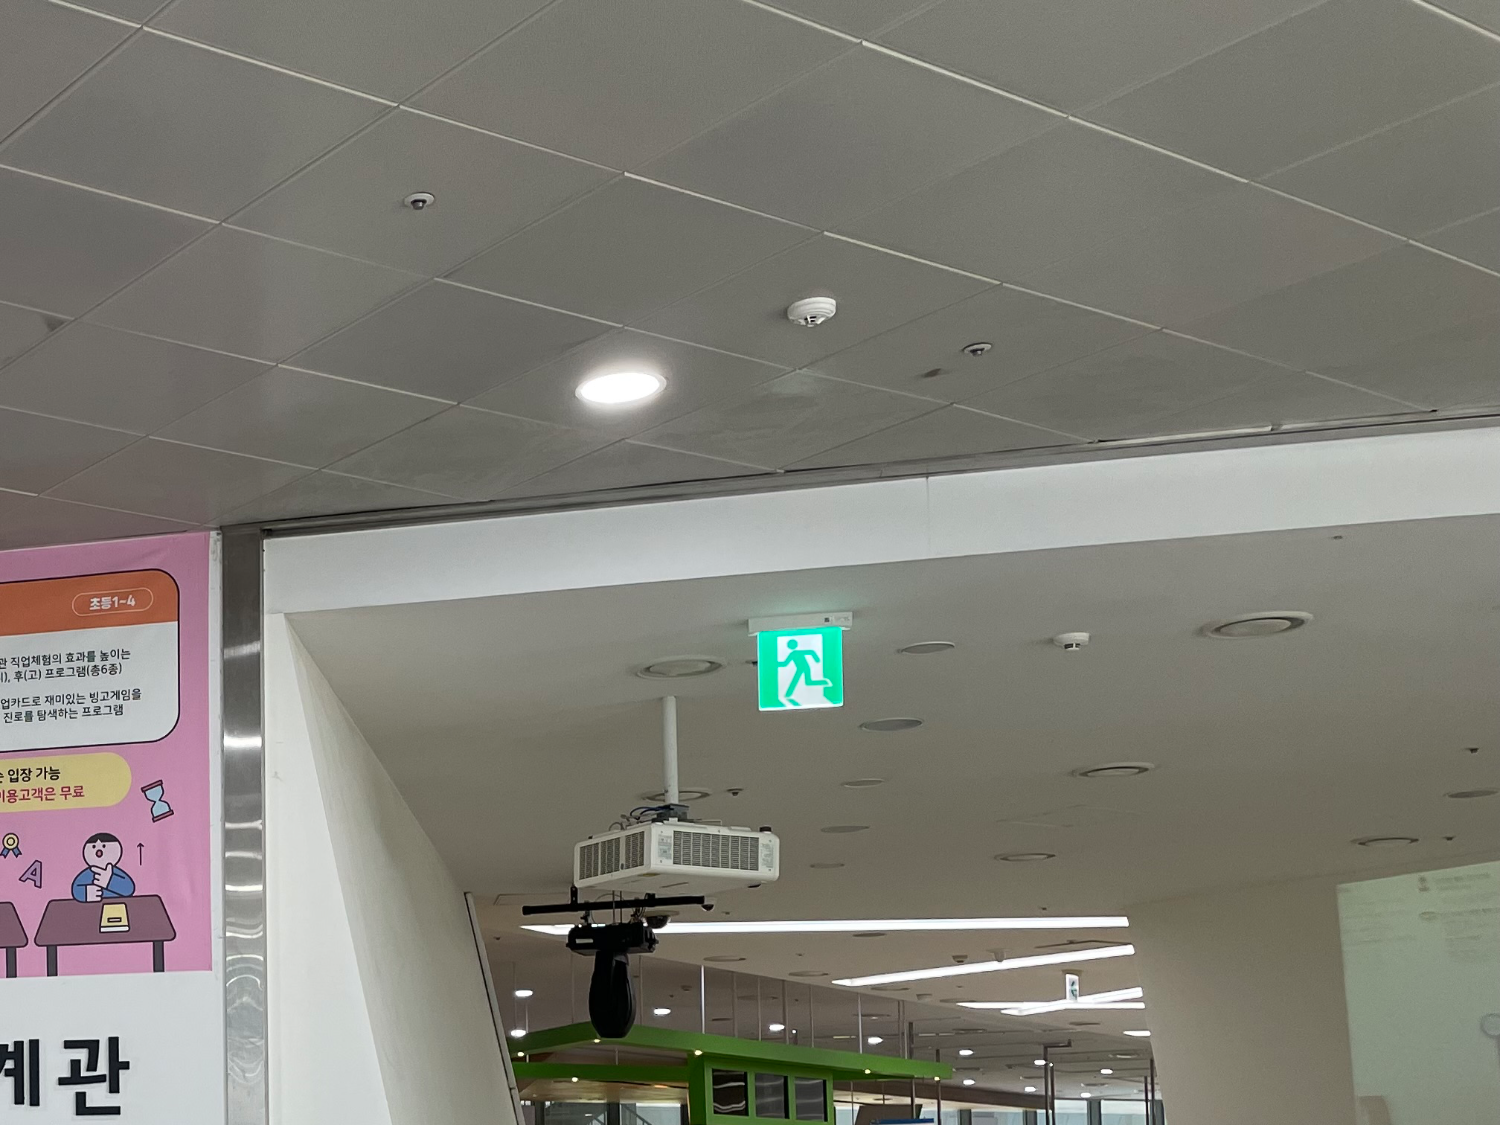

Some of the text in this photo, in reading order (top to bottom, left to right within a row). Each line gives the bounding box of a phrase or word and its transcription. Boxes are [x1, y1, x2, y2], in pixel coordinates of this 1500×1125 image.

[10, 654, 61, 668] 직업체험의
[65, 652, 95, 664] 효과를
[100, 649, 130, 662] 높이는
[44, 692, 85, 706] 재미있는
[89, 689, 141, 704] 빙고게임을
[3, 710, 33, 723] 진로를
[37, 707, 77, 721] 탐색하는
[82, 705, 123, 718] 프로그램
[8, 768, 32, 785] 입장
[36, 767, 60, 783] 가능
[60, 786, 84, 802] 무료
